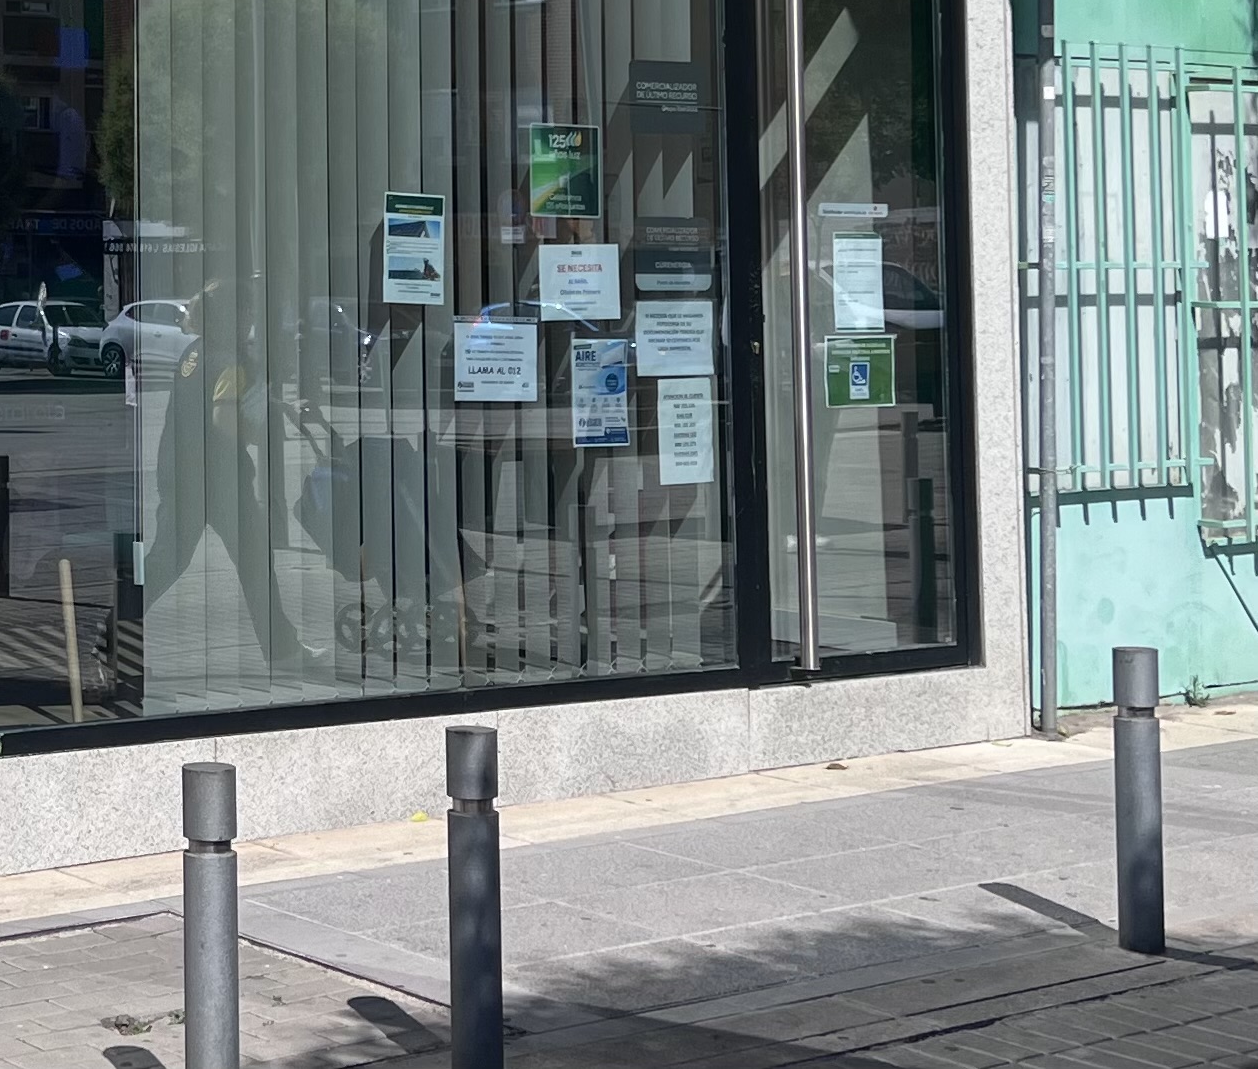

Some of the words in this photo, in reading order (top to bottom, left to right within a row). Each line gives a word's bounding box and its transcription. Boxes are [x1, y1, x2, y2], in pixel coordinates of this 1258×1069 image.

[575, 351, 597, 362] AIRE
[468, 366, 494, 375] LLAMA
[497, 367, 505, 375] AL
